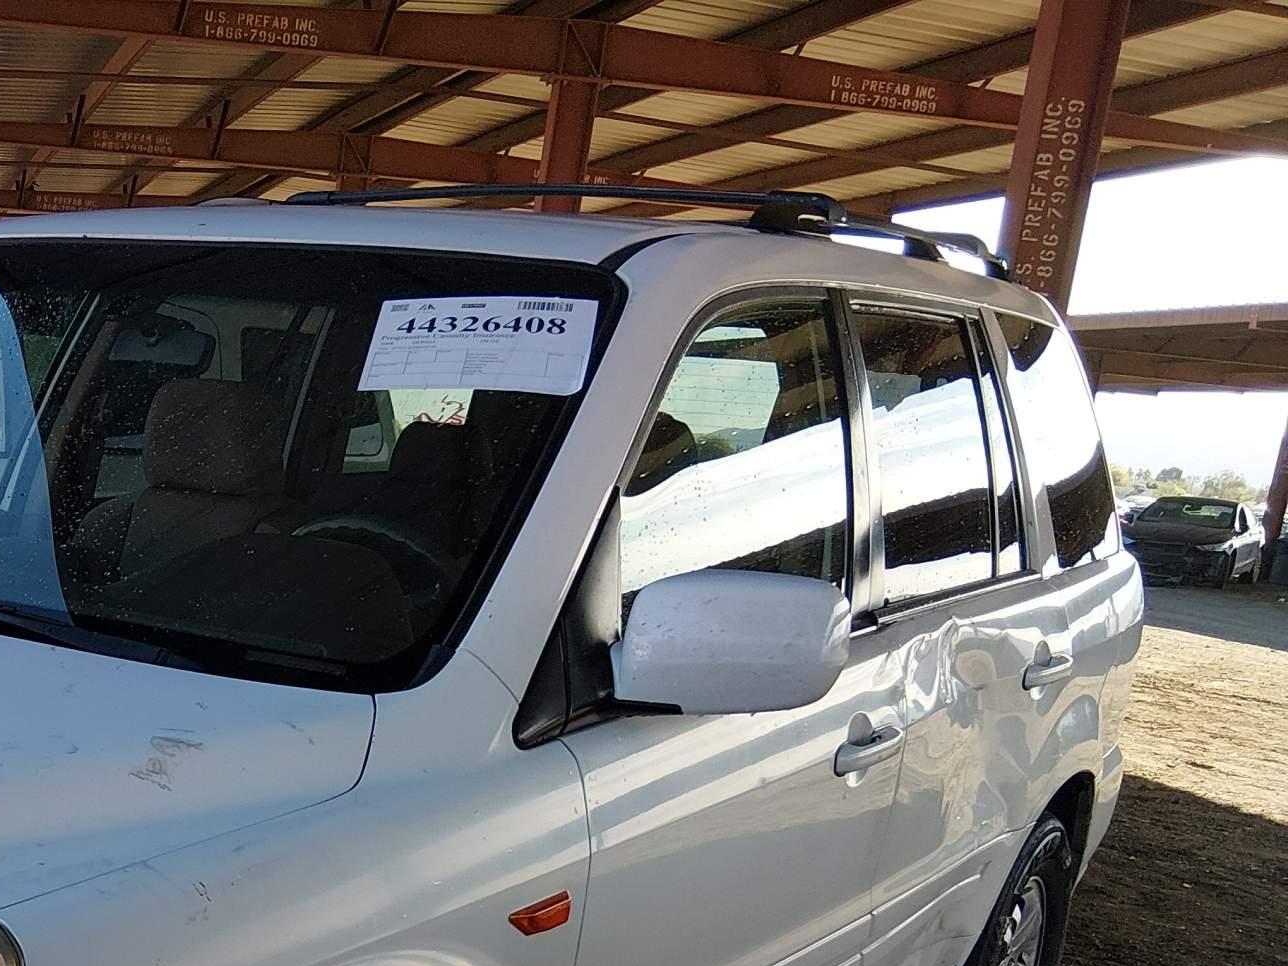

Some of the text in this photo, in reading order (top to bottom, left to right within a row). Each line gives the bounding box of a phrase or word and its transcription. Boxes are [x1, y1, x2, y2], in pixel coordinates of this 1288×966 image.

[205, 9, 320, 34] U.S. PREFAB INC.
[205, 25, 319, 47] 1-866-799-0969
[831, 75, 855, 90] U.S.
[861, 79, 910, 97] PREFAB
[1021, 152, 1054, 242] PREFAB
[1040, 96, 1066, 139] INC.
[396, 315, 567, 335] 44326408
[381, 333, 432, 341] Progressive
